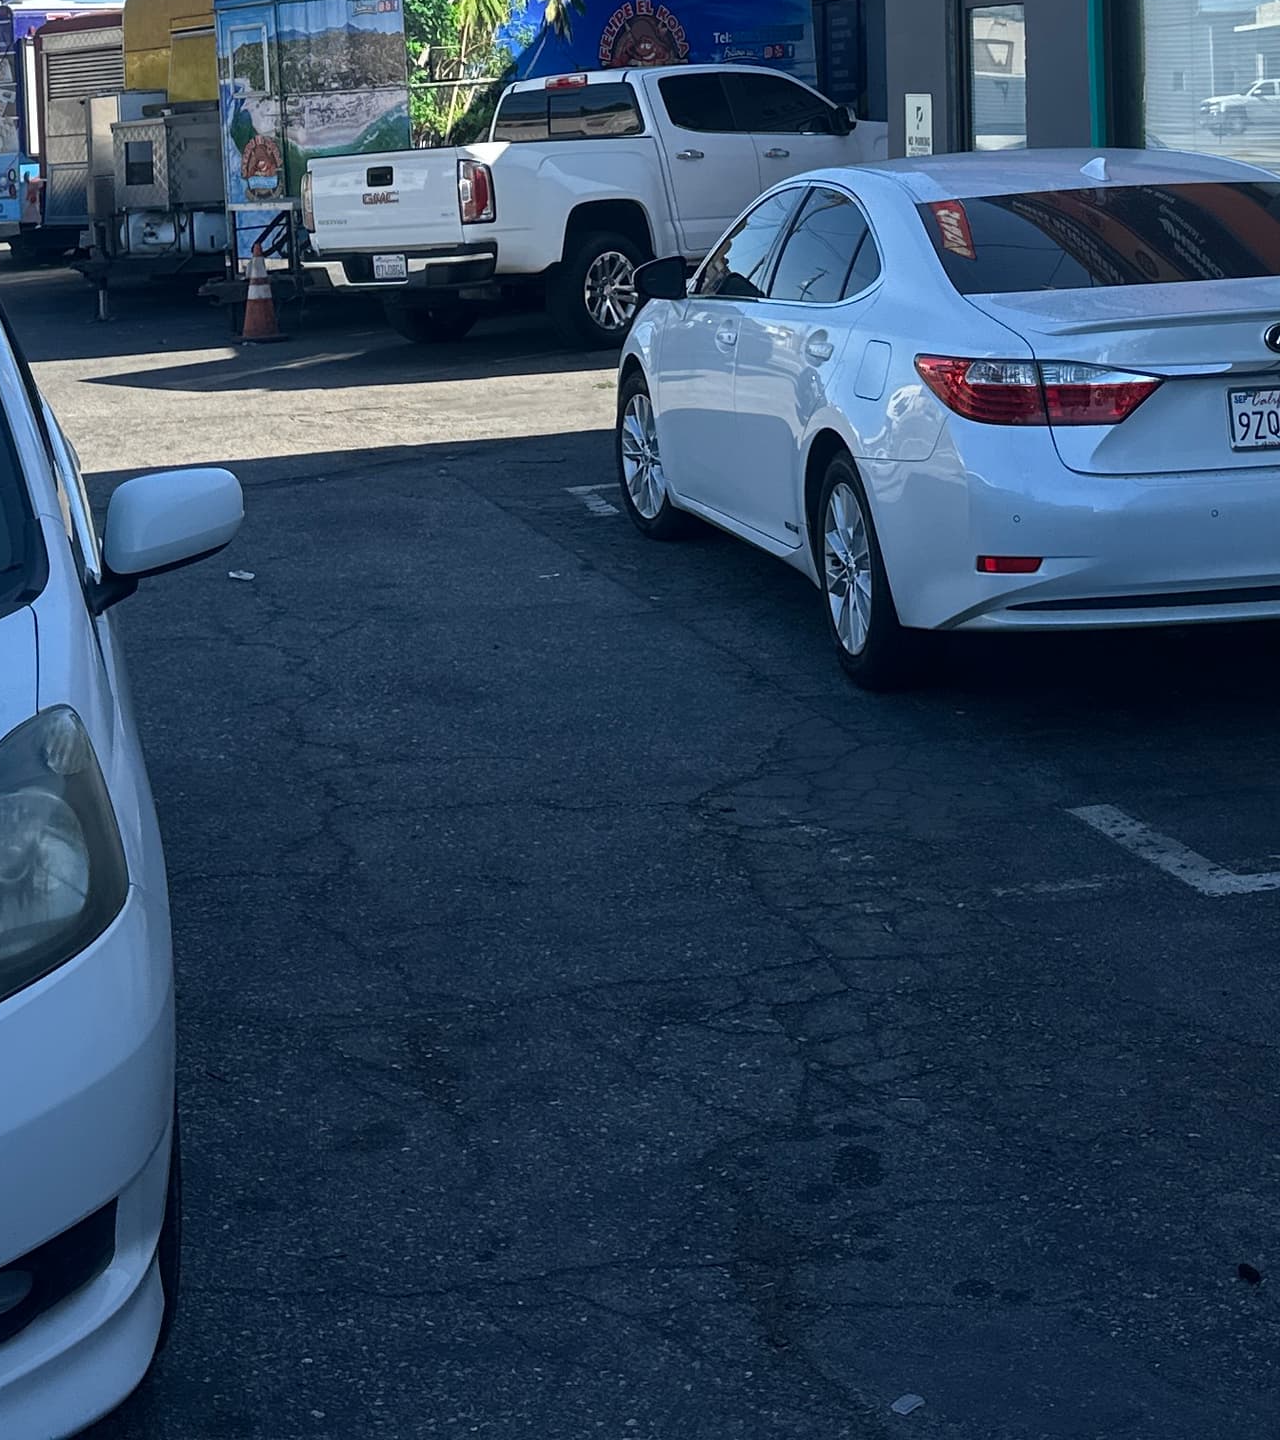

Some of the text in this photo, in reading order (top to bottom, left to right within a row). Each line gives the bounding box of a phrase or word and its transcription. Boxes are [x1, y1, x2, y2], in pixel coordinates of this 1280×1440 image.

[599, 0, 689, 61] FELIPE EL KORA
[713, 32, 732, 44] Tel:
[362, 190, 400, 206] GMC
